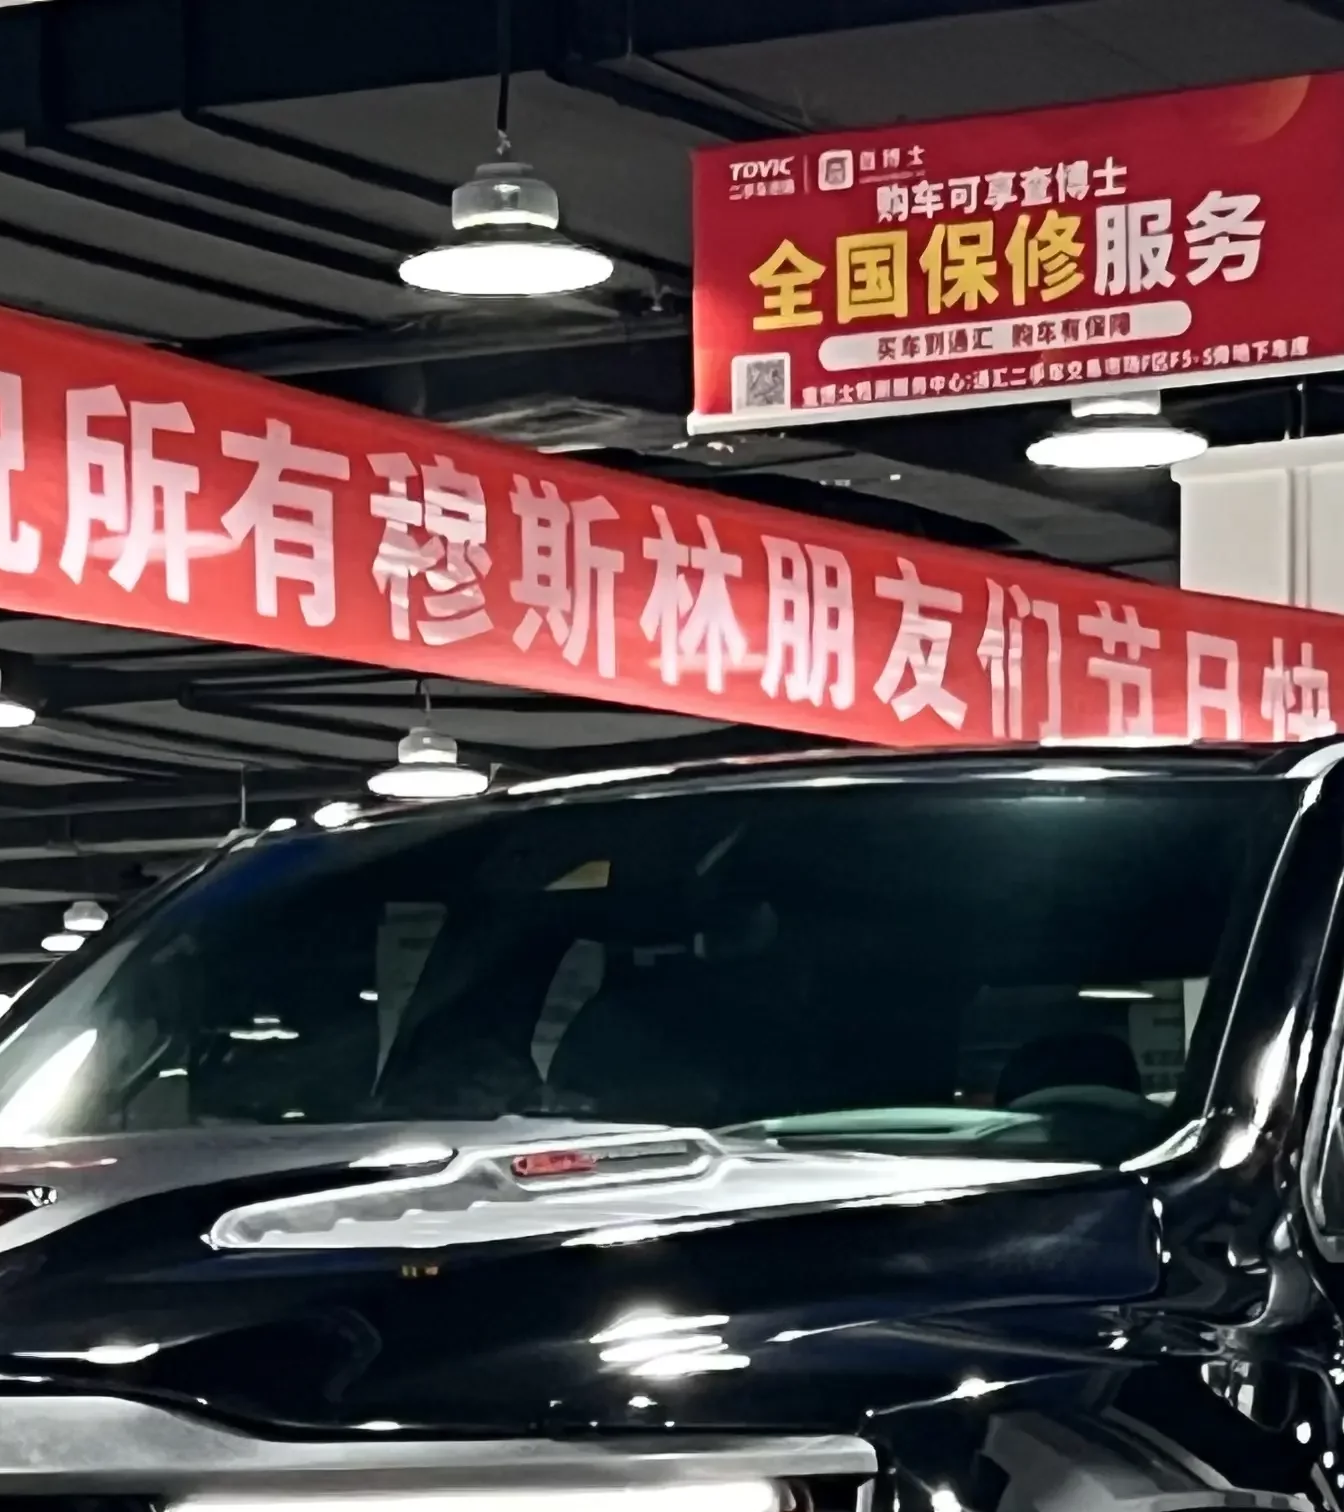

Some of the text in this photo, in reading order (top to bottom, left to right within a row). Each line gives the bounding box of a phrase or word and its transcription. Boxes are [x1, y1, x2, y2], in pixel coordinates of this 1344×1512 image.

[876, 157, 1127, 223] 购车可享查博士
[749, 193, 1267, 330] 全国保修服务
